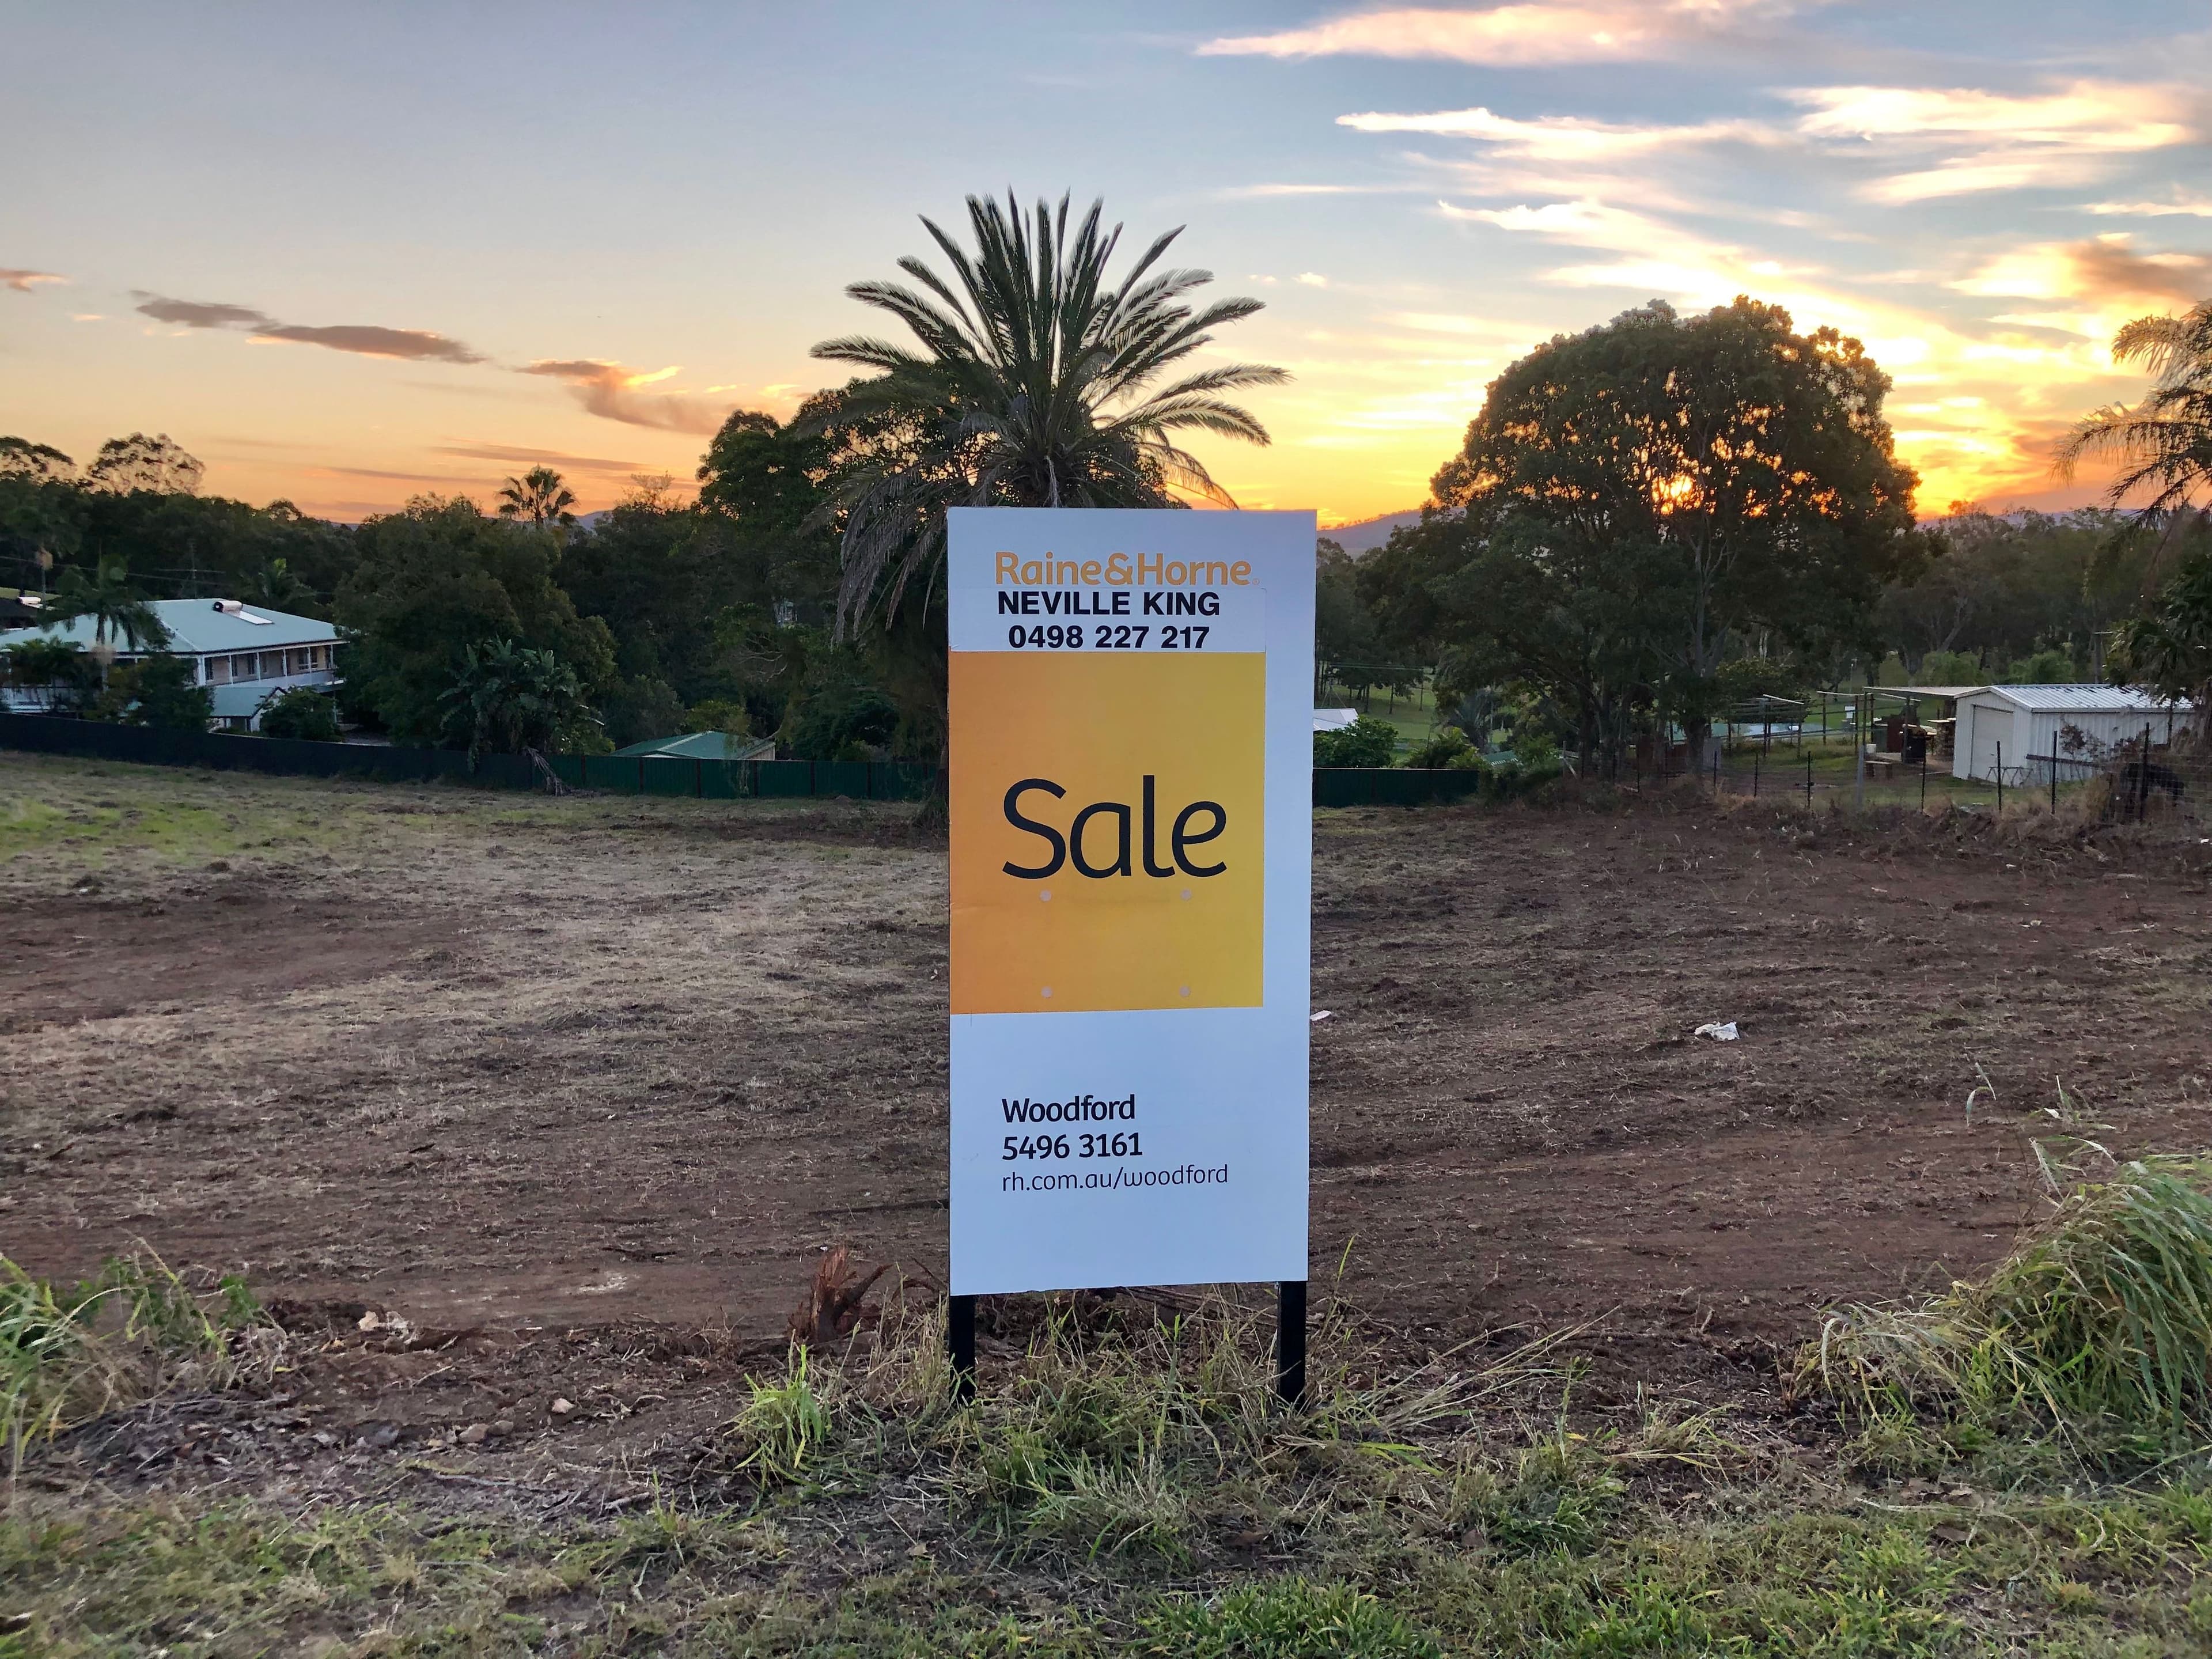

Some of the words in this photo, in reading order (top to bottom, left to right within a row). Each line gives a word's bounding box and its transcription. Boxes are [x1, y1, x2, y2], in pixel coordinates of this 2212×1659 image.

[995, 551, 1251, 586] Raine&Horne
[998, 591, 1131, 615] NEVILLE
[1143, 592, 1220, 616] KING
[1009, 625, 1084, 649] 0498
[1095, 626, 1149, 649] 227
[1161, 626, 1210, 649] 217
[1002, 775, 1228, 880] Sale
[1001, 1094, 1136, 1123] Woodford
[1002, 1134, 1070, 1161] 5496
[1078, 1132, 1143, 1158] 3161
[1002, 1164, 1229, 1192] rh.com.au/woodford
